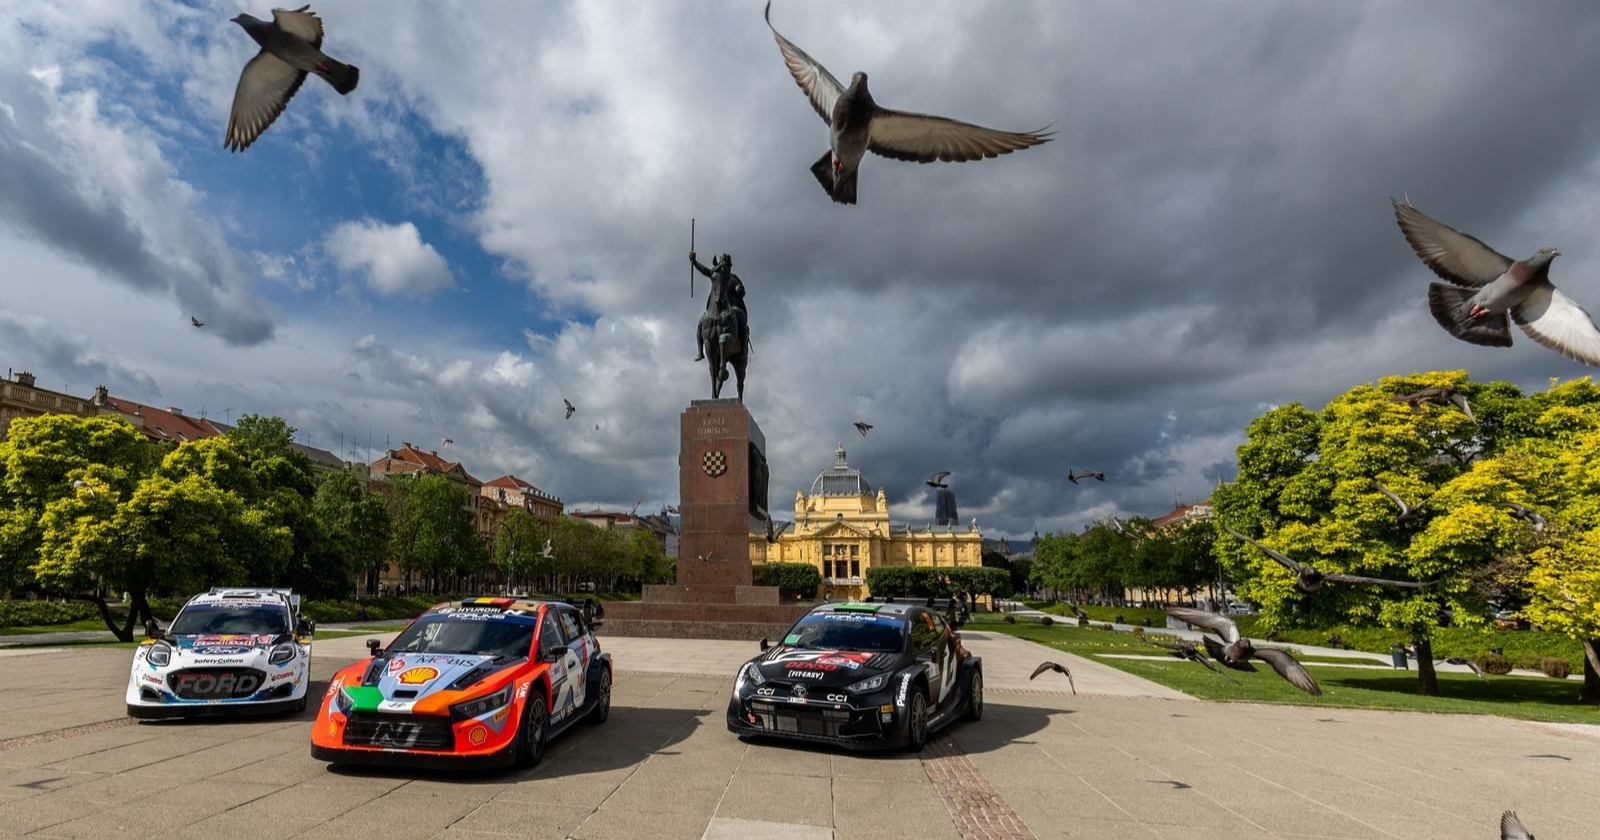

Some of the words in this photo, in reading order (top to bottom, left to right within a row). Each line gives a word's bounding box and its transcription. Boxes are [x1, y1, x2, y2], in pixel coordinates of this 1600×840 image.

[416, 657, 477, 667] MOBIS
[784, 661, 838, 671] DENSO
[146, 675, 163, 685] Castrol
[276, 671, 294, 680] Castrol
[175, 673, 258, 694] FORD
[897, 673, 911, 707] Panasonic
[827, 693, 848, 702] CCI
